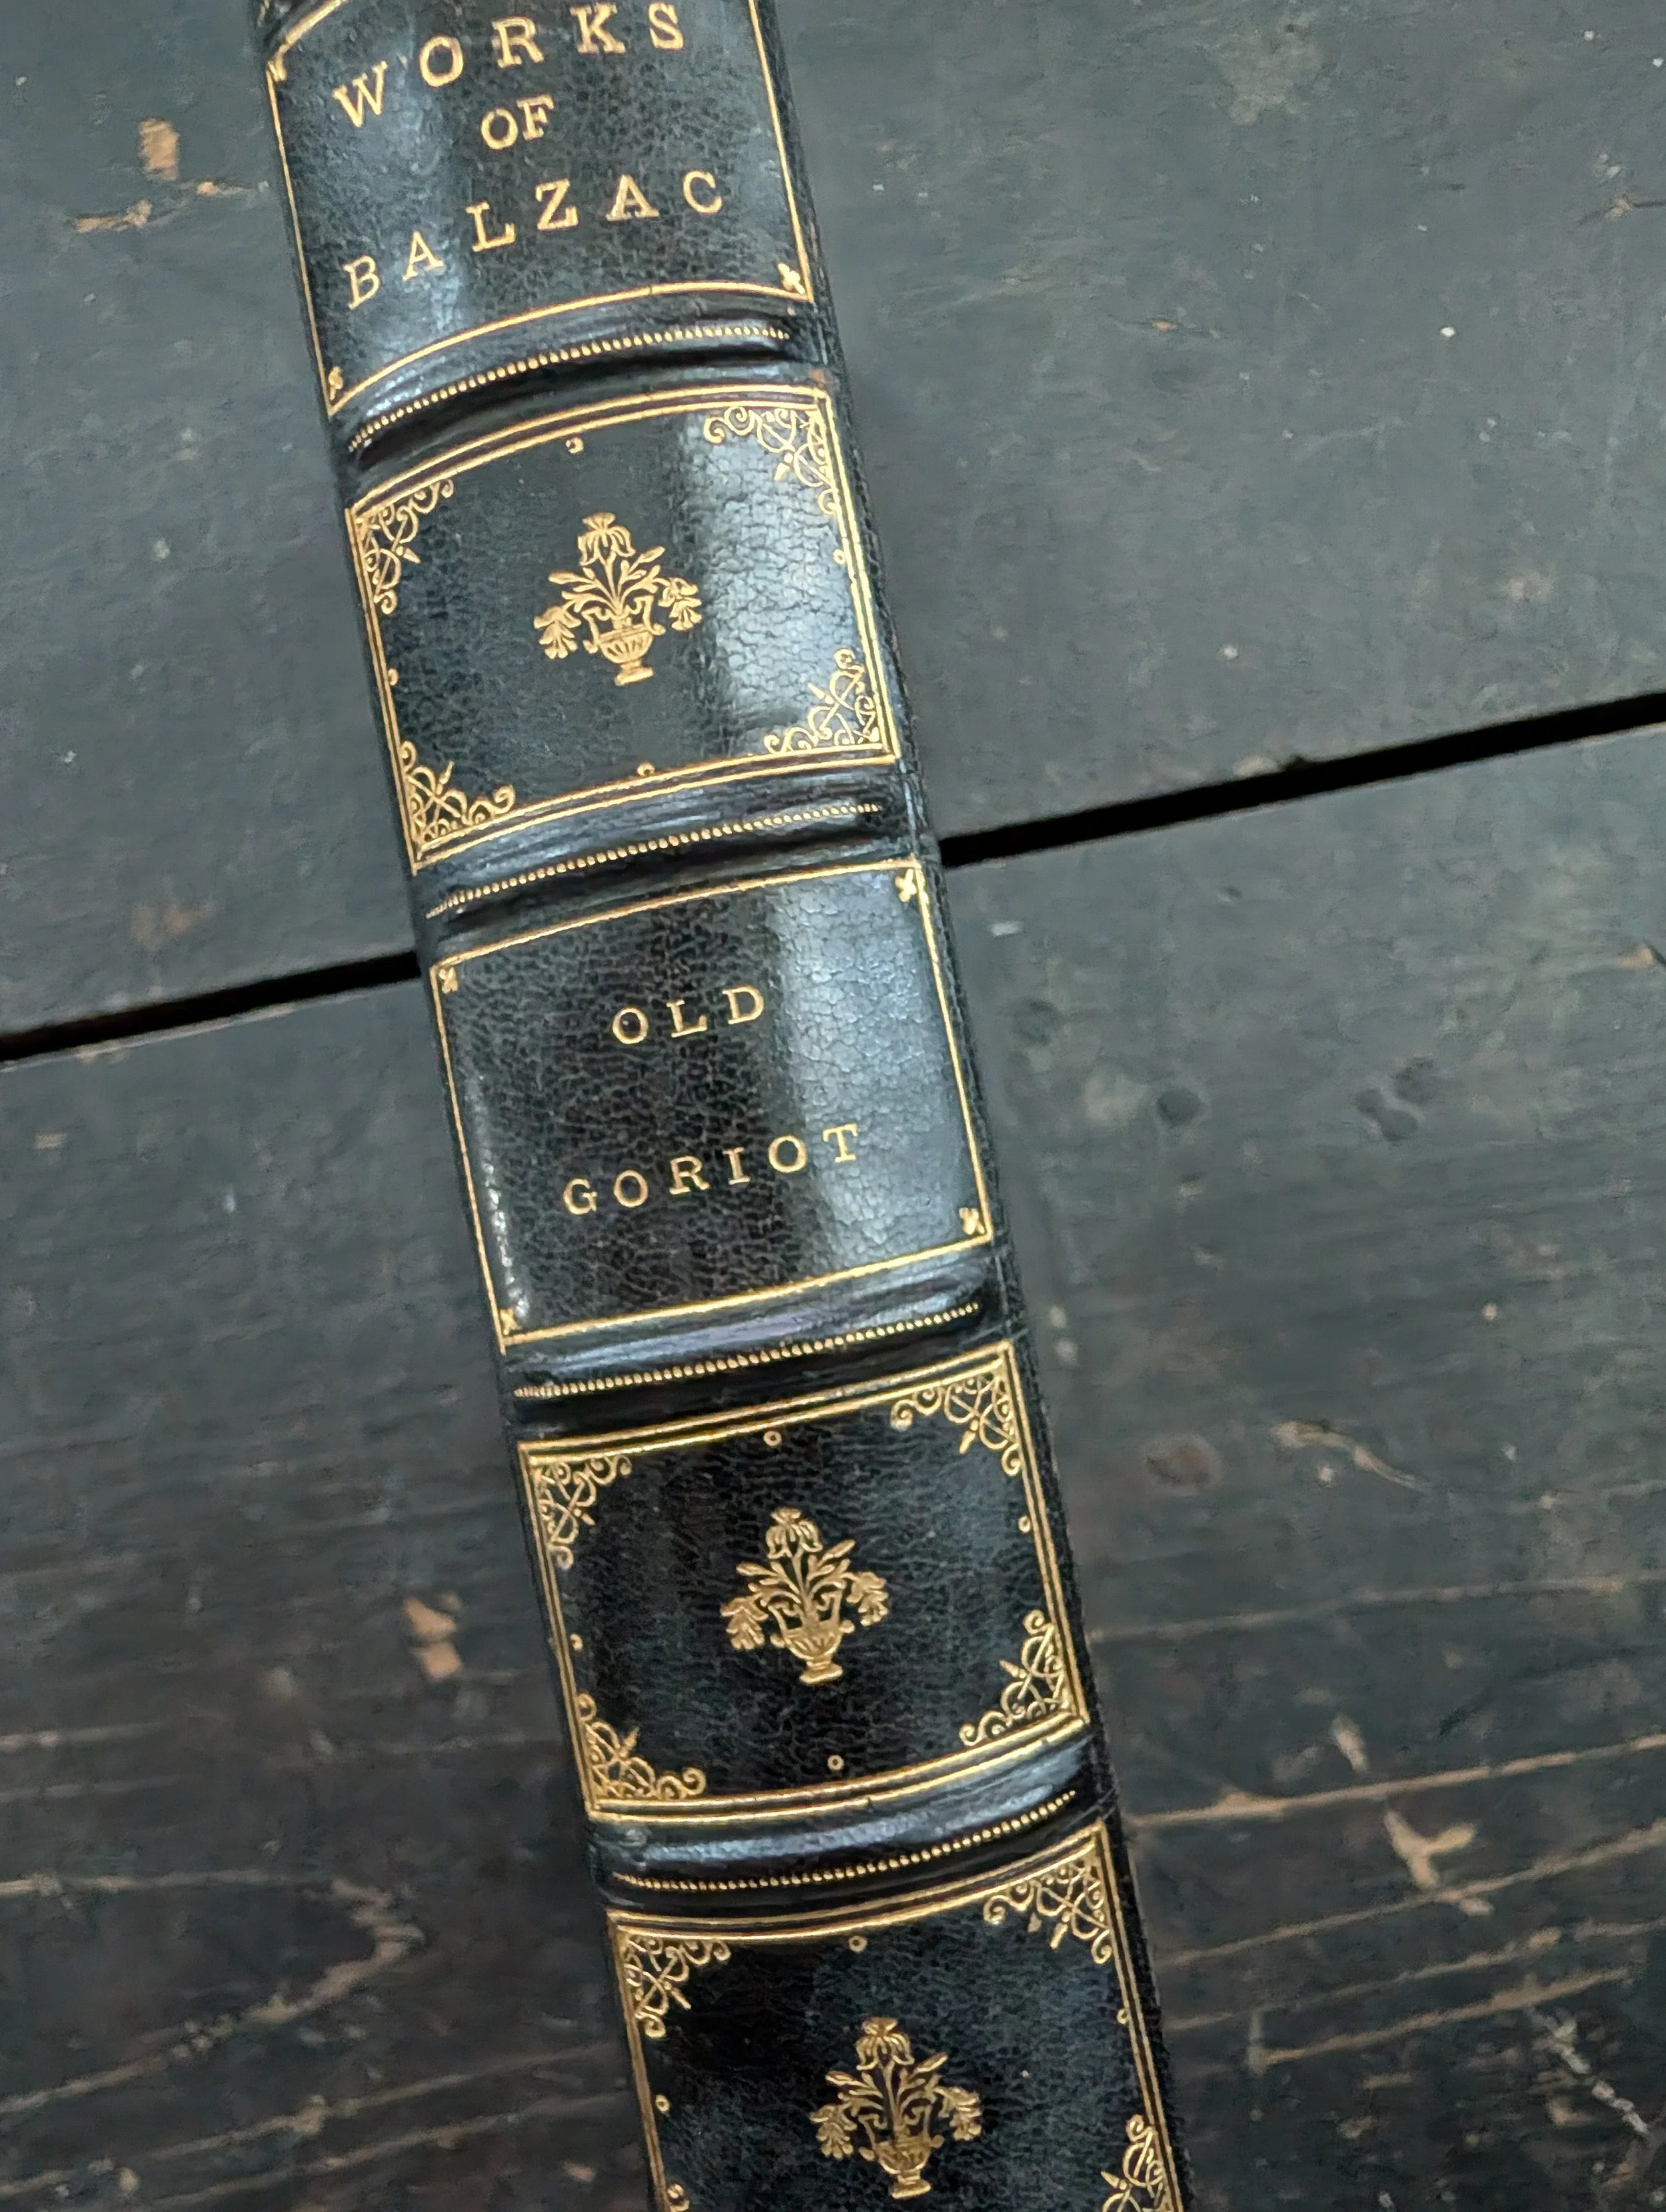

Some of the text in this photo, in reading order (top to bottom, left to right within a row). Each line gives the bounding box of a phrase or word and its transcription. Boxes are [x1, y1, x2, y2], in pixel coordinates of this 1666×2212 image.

[333, 1, 684, 127] WORKS
[480, 94, 554, 150] OF
[343, 170, 723, 309] BALZAC
[612, 985, 764, 1044] OLD
[563, 1123, 859, 1215] GORIOT
